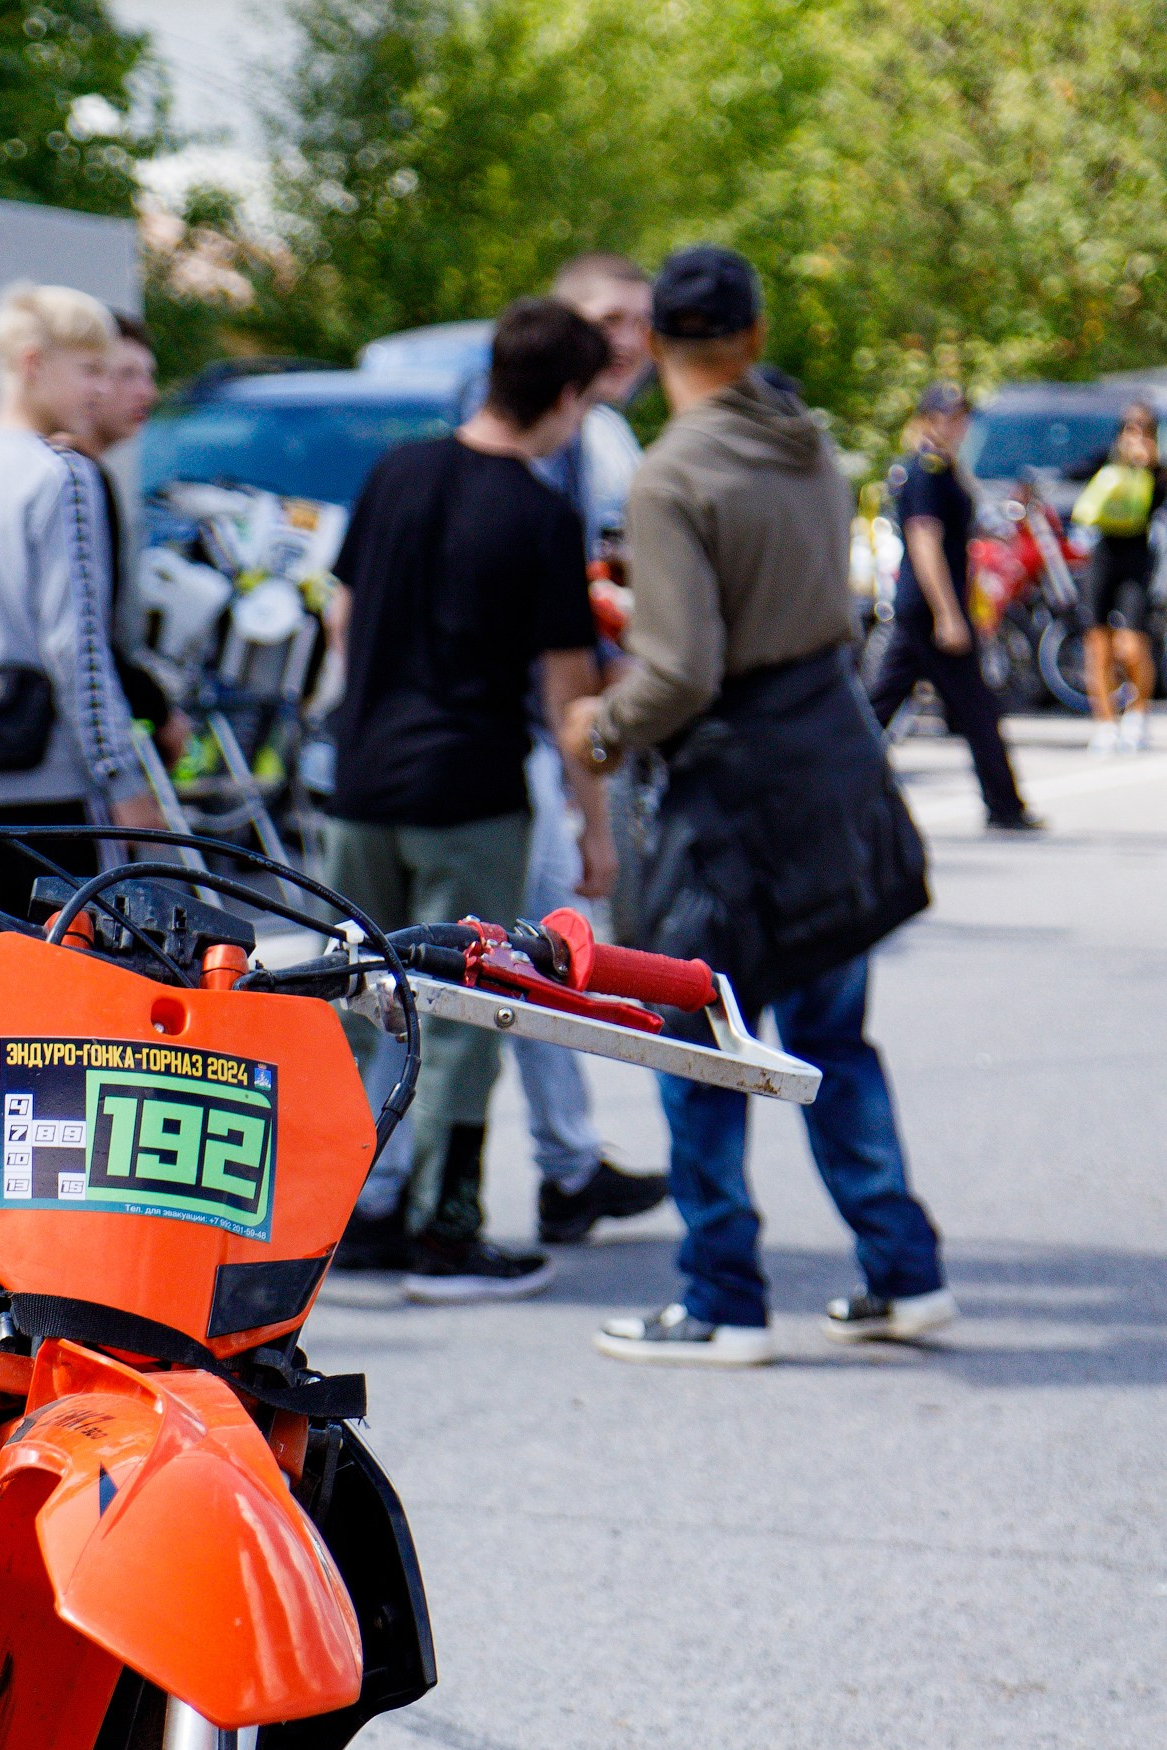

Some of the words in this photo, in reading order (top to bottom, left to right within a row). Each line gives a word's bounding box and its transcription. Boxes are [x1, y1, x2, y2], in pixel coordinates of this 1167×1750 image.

[6, 1043, 203, 1077] ЭНДУРО-ГОНКА-ГОРНАЗ
[207, 1058, 249, 1086] 2024
[8, 1098, 30, 1115] 4
[8, 1124, 29, 1142] 7
[35, 1124, 56, 1142] 8
[62, 1125, 83, 1142] 9
[103, 1096, 265, 1200] 192
[6, 1152, 30, 1165] 10
[6, 1178, 30, 1191] 13
[124, 1203, 142, 1213] Тел.
[145, 1207, 161, 1216] для
[163, 1210, 208, 1223] эвакуации:
[209, 1216, 219, 1225] +7
